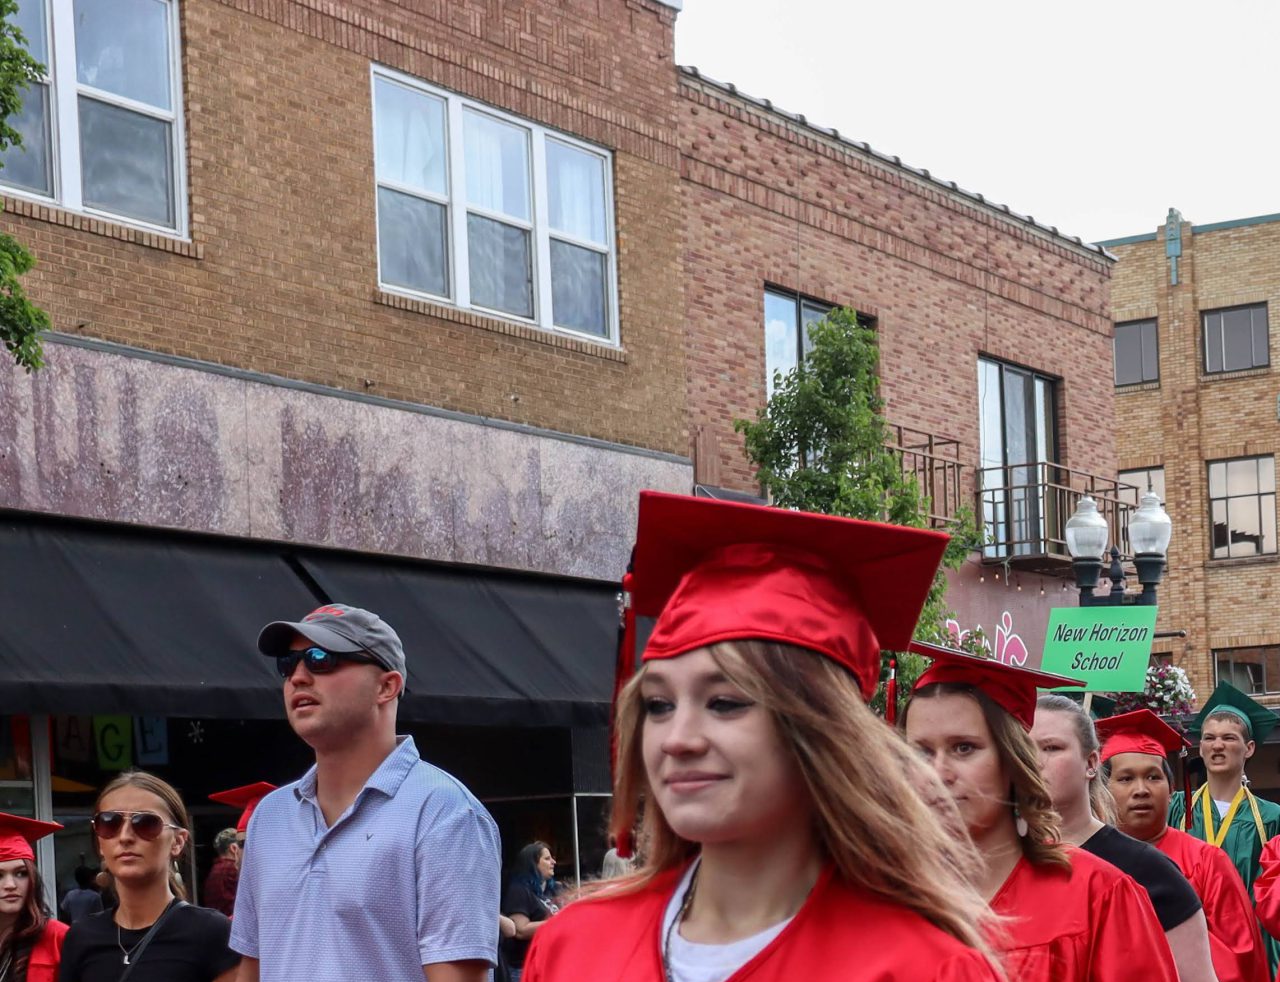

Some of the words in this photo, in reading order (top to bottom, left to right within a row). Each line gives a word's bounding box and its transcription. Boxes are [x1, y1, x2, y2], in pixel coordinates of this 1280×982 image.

[1053, 624, 1088, 642] New
[1090, 622, 1148, 642] Horizon
[1071, 651, 1124, 672] School
